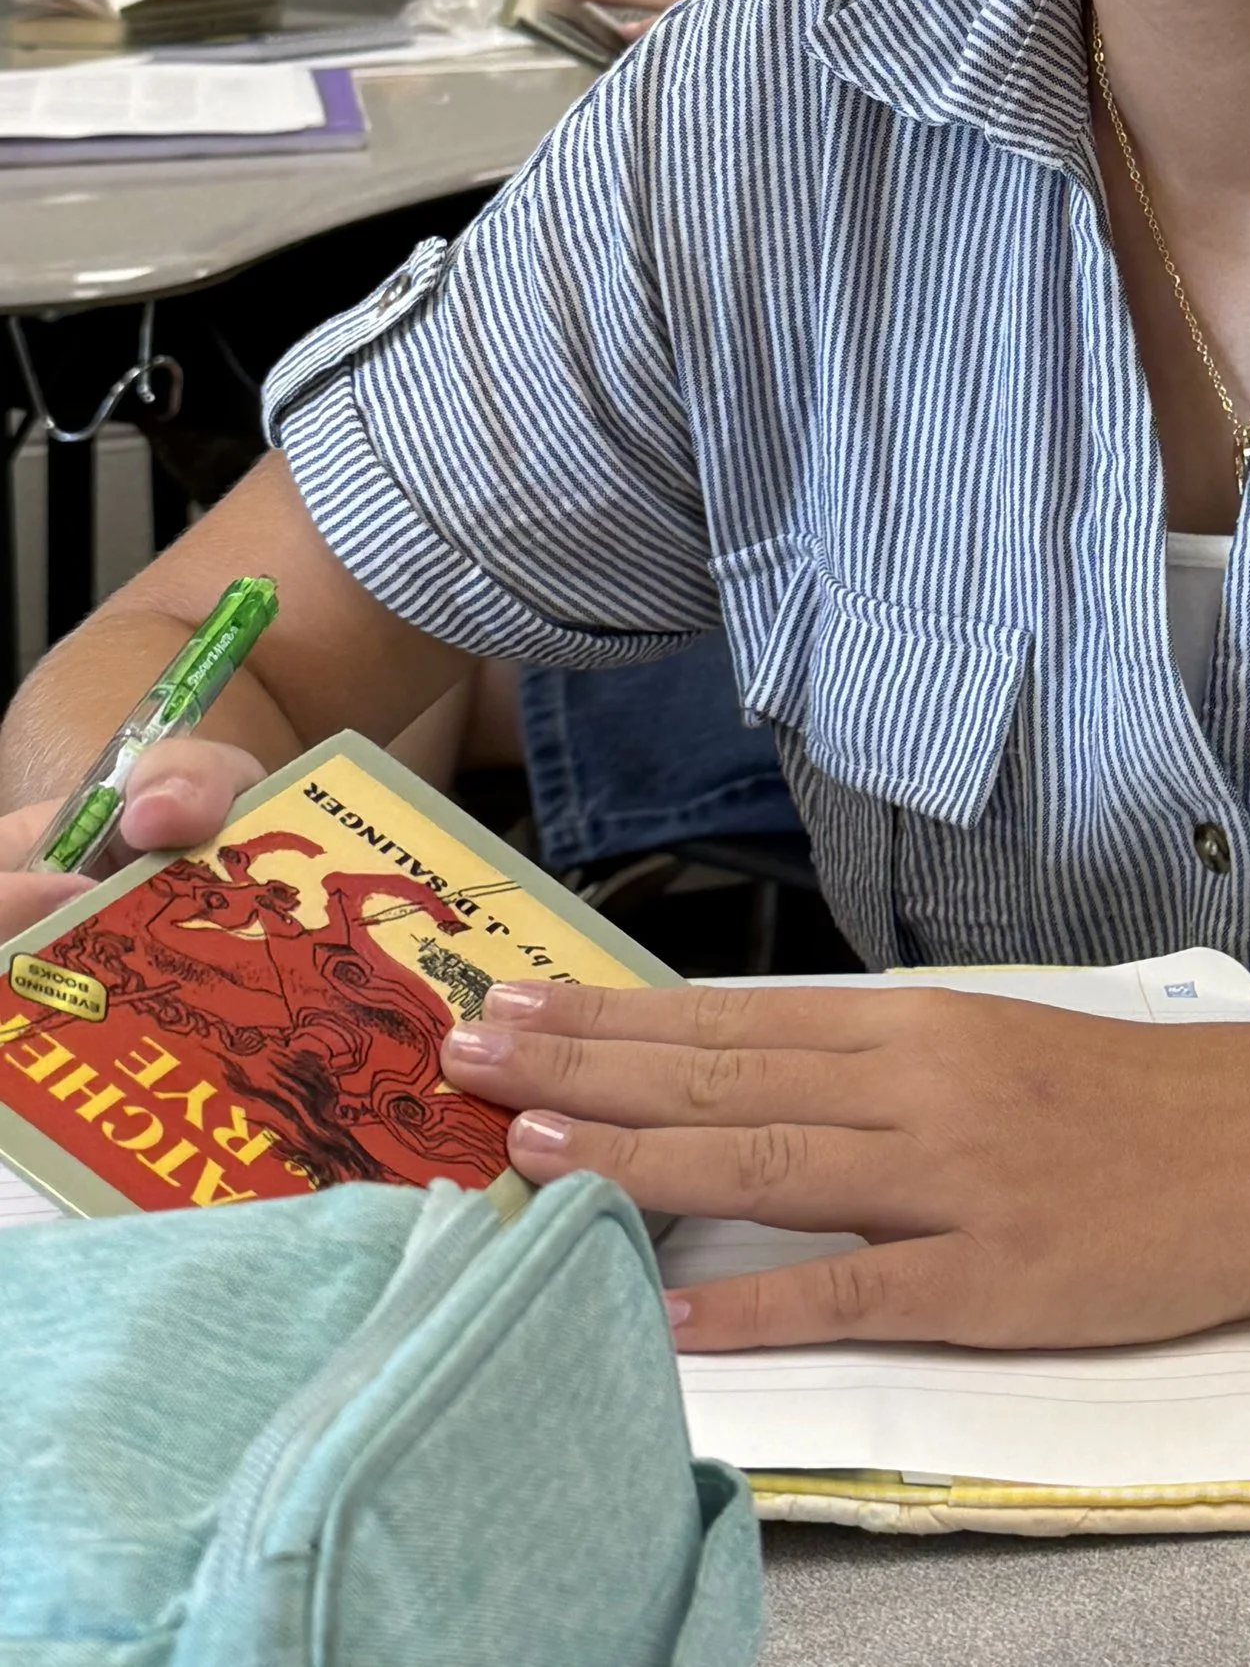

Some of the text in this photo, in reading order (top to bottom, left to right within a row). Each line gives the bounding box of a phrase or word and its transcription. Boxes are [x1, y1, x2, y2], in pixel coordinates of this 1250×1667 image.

[302, 782, 449, 893] SALINGER
[486, 914, 511, 936] J.
[516, 943, 554, 967] by
[14, 975, 100, 1014] EVERBIND
[28, 963, 90, 994] BOOKS
[114, 1036, 281, 1166] RYE
